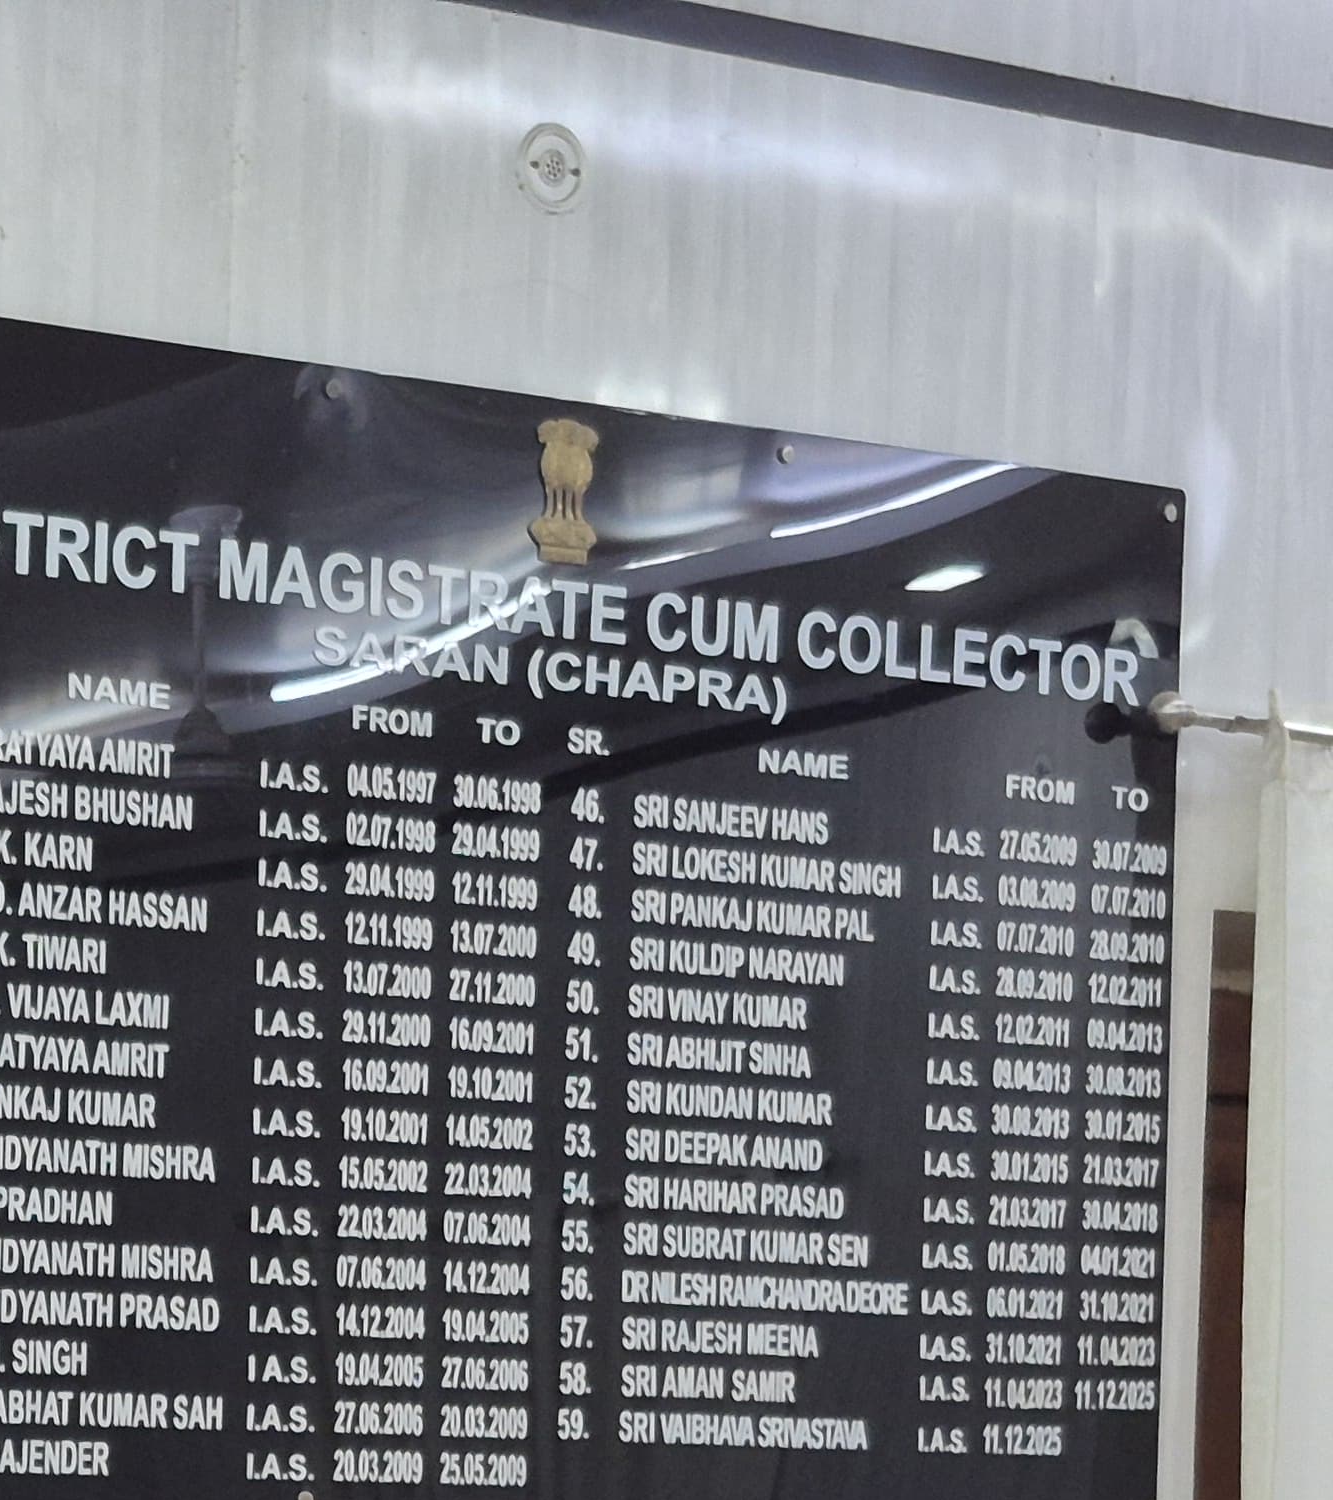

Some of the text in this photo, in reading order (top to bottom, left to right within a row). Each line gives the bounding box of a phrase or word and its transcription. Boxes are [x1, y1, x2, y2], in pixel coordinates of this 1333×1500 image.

[218, 537, 628, 646] MAGISTRATE
[646, 592, 781, 664] CUM
[798, 611, 1141, 706] COLLECTOR
[313, 626, 788, 725] SARAN (CHAPRA)
[68, 672, 172, 710] NAME
[352, 703, 433, 738] FROM
[475, 717, 521, 746] TO
[98, 736, 176, 779] AMRIT
[260, 759, 329, 794] I.A.S.
[347, 763, 437, 804] 04.05.1997
[452, 773, 542, 815] 30.06.1998
[567, 726, 1149, 812] SR. NAME FROM TO
[74, 785, 193, 831] BHUSHAN
[570, 787, 829, 845] 46. SRI SANJEEV HANS
[24, 831, 93, 872] KARN
[569, 835, 902, 899] 47. SRI LOKESH KUMAR SINGH
[17, 881, 103, 924] ANZAR
[108, 889, 208, 933] HASSAN
[568, 883, 875, 942] 48. SRI PANKAJ KUMAR PAL
[21, 933, 107, 975] TIWARI
[567, 930, 845, 987] 49. SRI KULDIP NARAYAN
[6, 982, 91, 1024] VIJAYA
[95, 989, 170, 1030] LAXMI
[566, 979, 807, 1031] 50. SRI VINAY KUMAR
[92, 1039, 170, 1079] AMRIT
[564, 1026, 812, 1079] 51. SRI ABHIJIT SINHA
[67, 1088, 156, 1129] KUMAR
[564, 1075, 833, 1126] 52. SRI KUNDAN KUMAR
[122, 1142, 216, 1183] MISHRA
[563, 1123, 823, 1172] 53. SRI DEEPAK ANAND
[562, 1170, 845, 1220] 54. SRI HARIHAR PRASAD
[561, 1218, 869, 1268] 55. SRI SUBRAT KUMAR SEN
[121, 1243, 214, 1283] MISHRA
[250, 1256, 318, 1287] I.A.S.
[336, 1254, 427, 1291] 07.06.2004
[443, 1259, 530, 1296] 14.12.2004
[560, 1266, 593, 1302] 56.
[119, 1292, 220, 1332] PRASAD
[560, 1314, 819, 1358] 57. SRI RAJESH MEENA
[11, 1338, 88, 1376] SINGH
[559, 1360, 796, 1403] 58. SRI AMAN SAMIR
[79, 1391, 168, 1429] KUMAR
[172, 1394, 223, 1431] SAH
[246, 1403, 316, 1433] I.A.S.
[333, 1399, 424, 1437] 27.06.2006
[440, 1403, 528, 1440] 20.03.2009
[557, 1407, 1062, 1457] 59. SRI VAIBHAVA SRIVASTAVA I.A.S. 11.12.2025
[246, 1452, 315, 1482] I.A.S.
[332, 1448, 424, 1485] 20.03.2009
[439, 1451, 527, 1488] 25.05.2009
